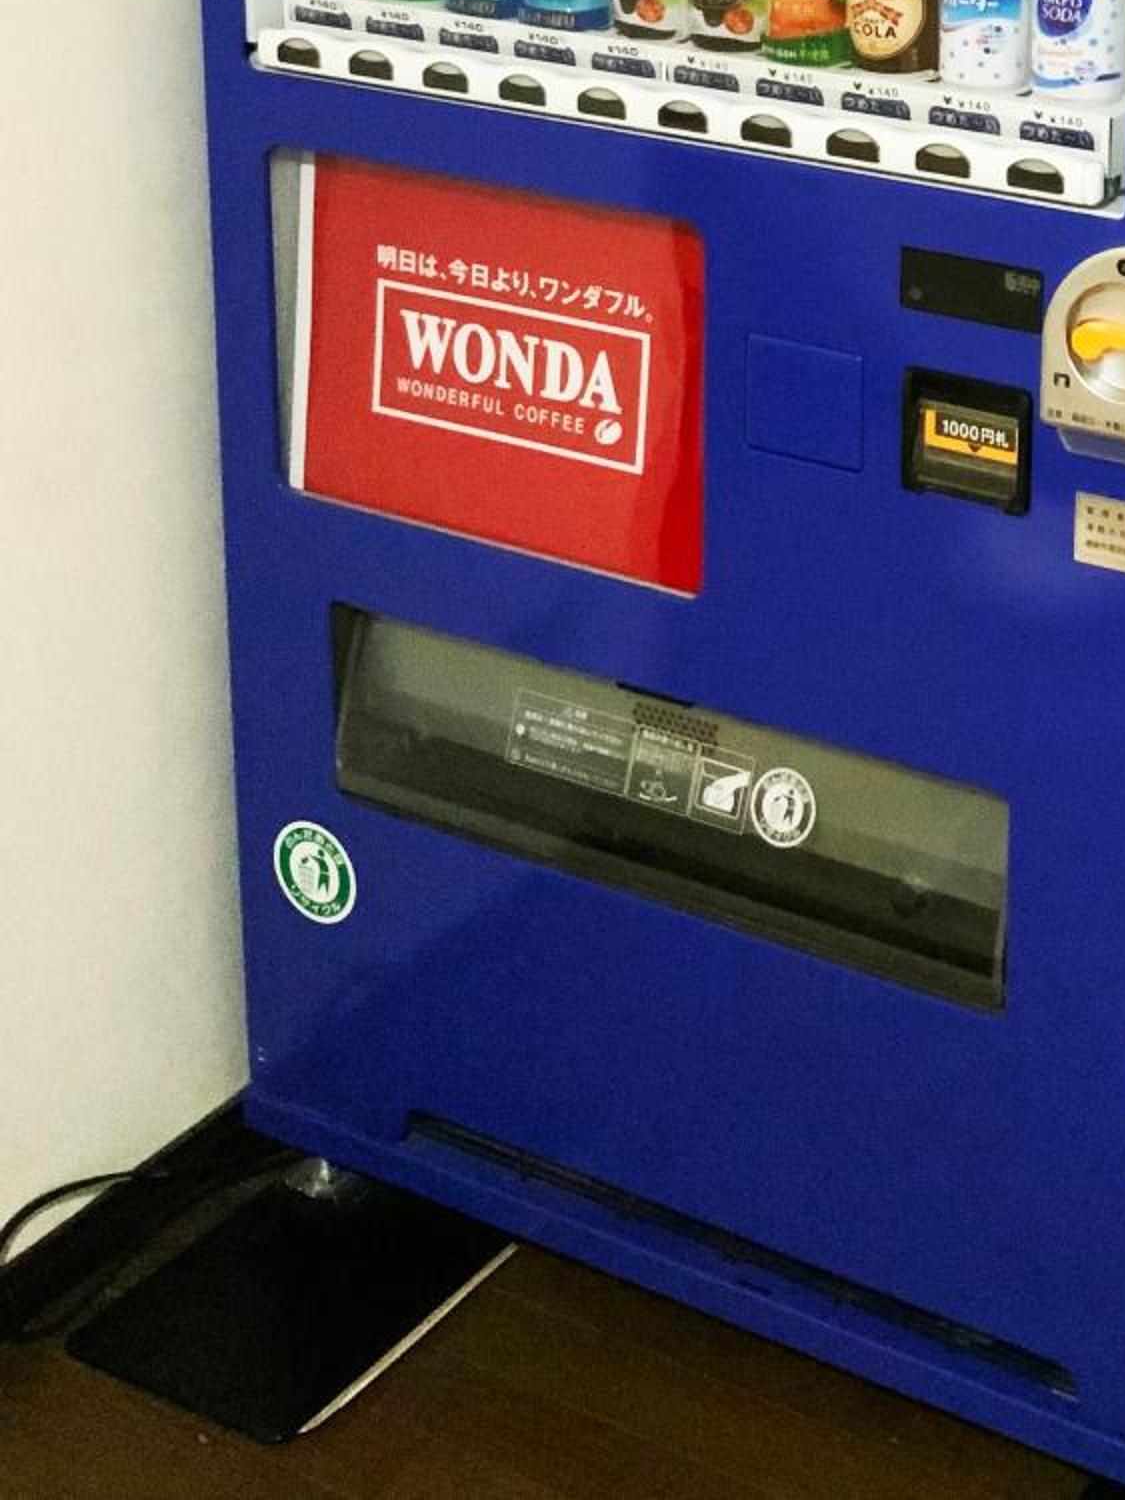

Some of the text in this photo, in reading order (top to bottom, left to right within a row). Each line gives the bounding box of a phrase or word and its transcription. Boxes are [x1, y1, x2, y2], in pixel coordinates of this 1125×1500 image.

[853, 21, 898, 39] COLA
[1041, 3, 1082, 23] SODA
[376, 244, 654, 324] 明日は、今日より、ワンダフル。
[399, 308, 623, 415] WONDA
[396, 376, 586, 435] WONDERFUL COFFEE
[941, 418, 1010, 448] 1000円札
